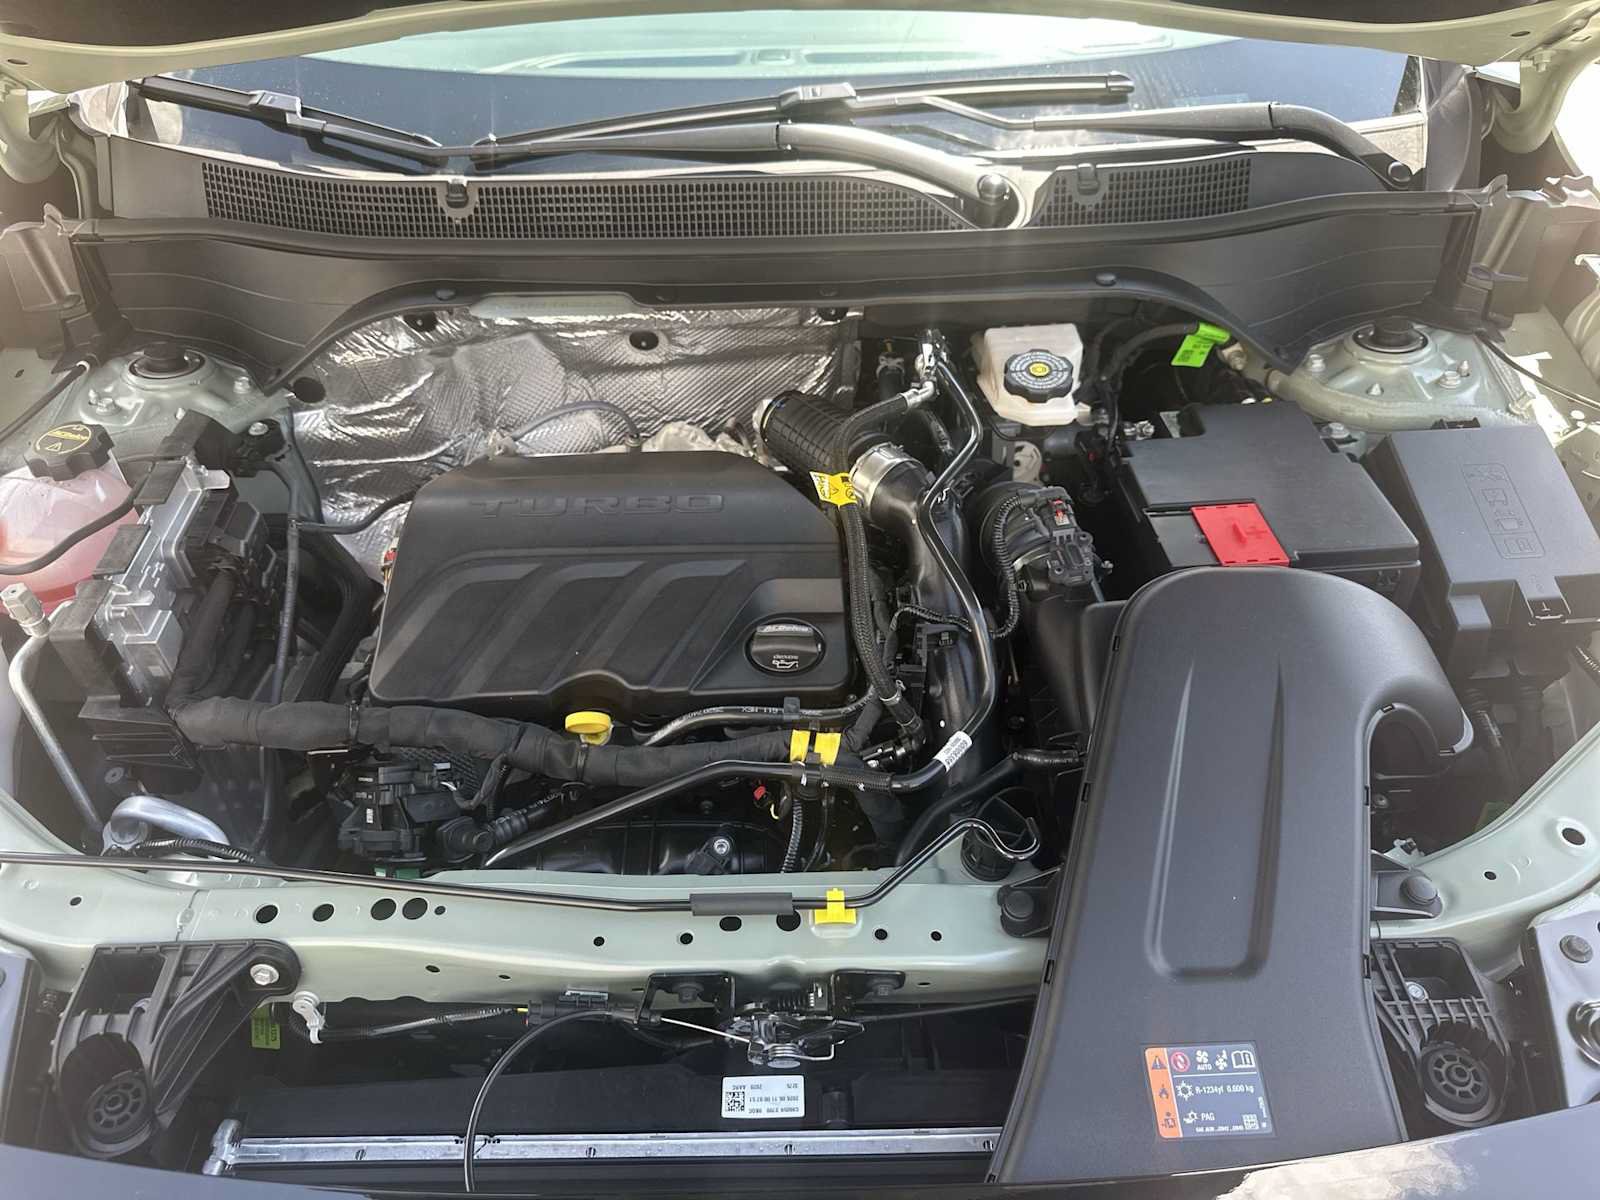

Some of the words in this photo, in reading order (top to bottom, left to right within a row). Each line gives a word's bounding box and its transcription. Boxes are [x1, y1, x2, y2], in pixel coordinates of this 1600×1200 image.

[470, 494, 725, 518] TURBO
[1195, 1085, 1224, 1095] R-1234yf
[1245, 1084, 1254, 1094] kg
[1201, 1112, 1215, 1121] PAG
